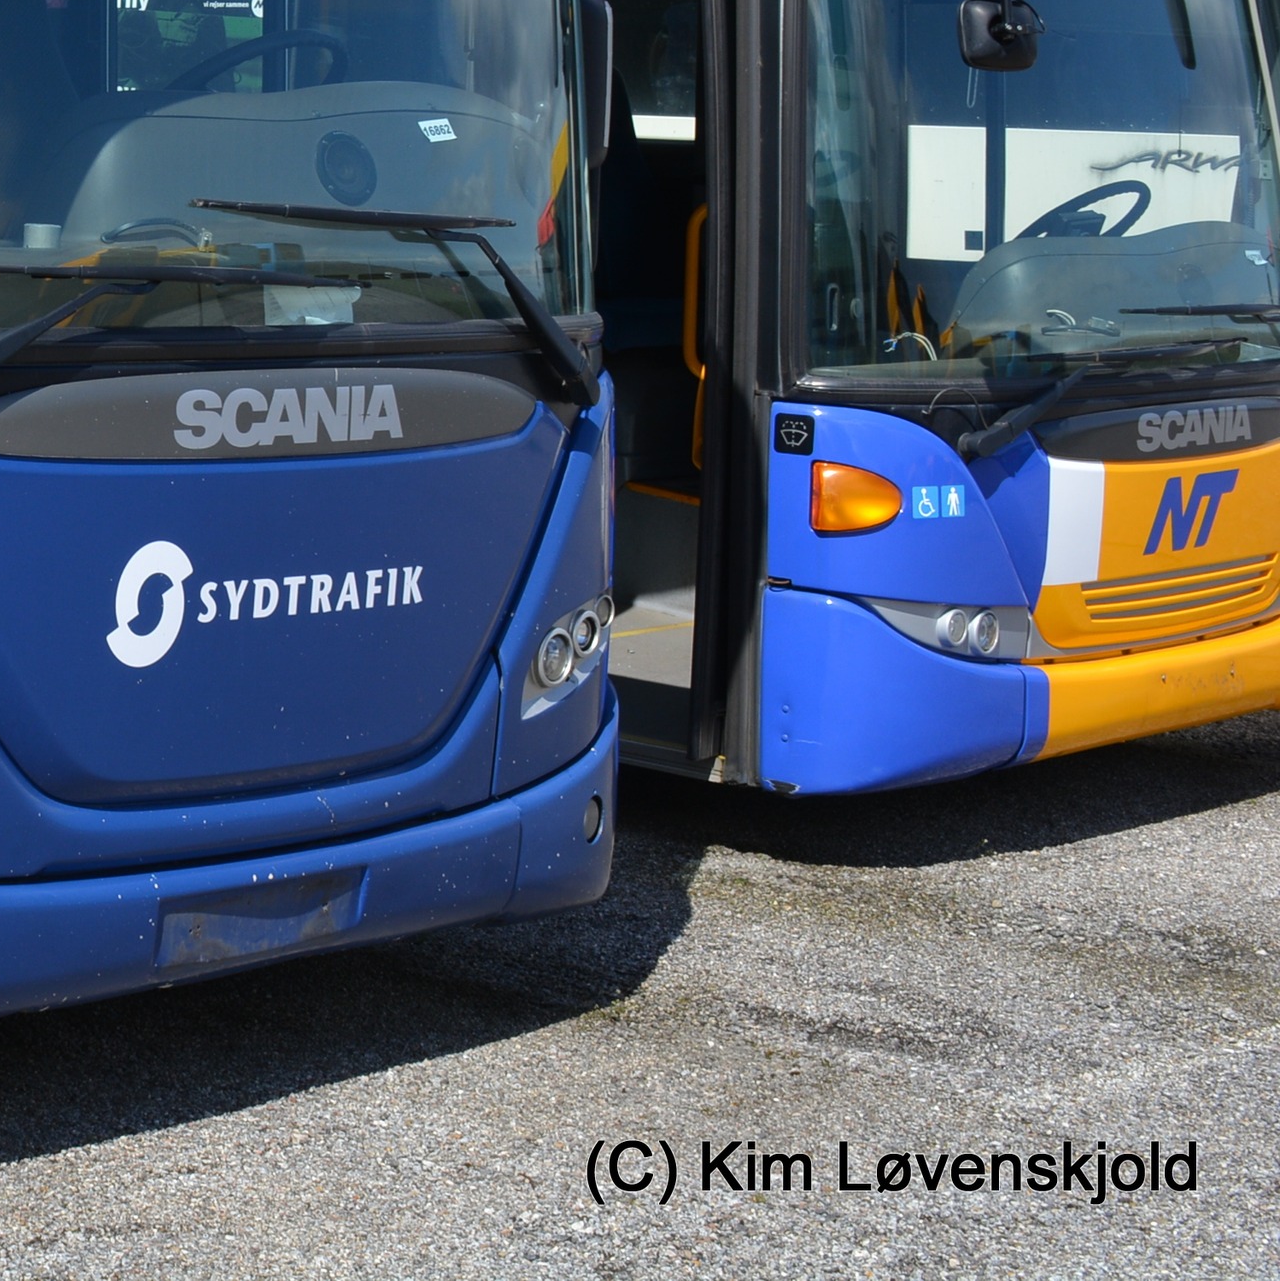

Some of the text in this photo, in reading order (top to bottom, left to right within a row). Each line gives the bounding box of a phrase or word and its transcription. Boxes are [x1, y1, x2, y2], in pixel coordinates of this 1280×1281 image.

[423, 123, 452, 137] 16862
[173, 384, 404, 450] SCANIA
[1136, 404, 1252, 453] SCANIA
[1142, 468, 1240, 556] NT
[197, 565, 424, 624] SYDTRAFIK
